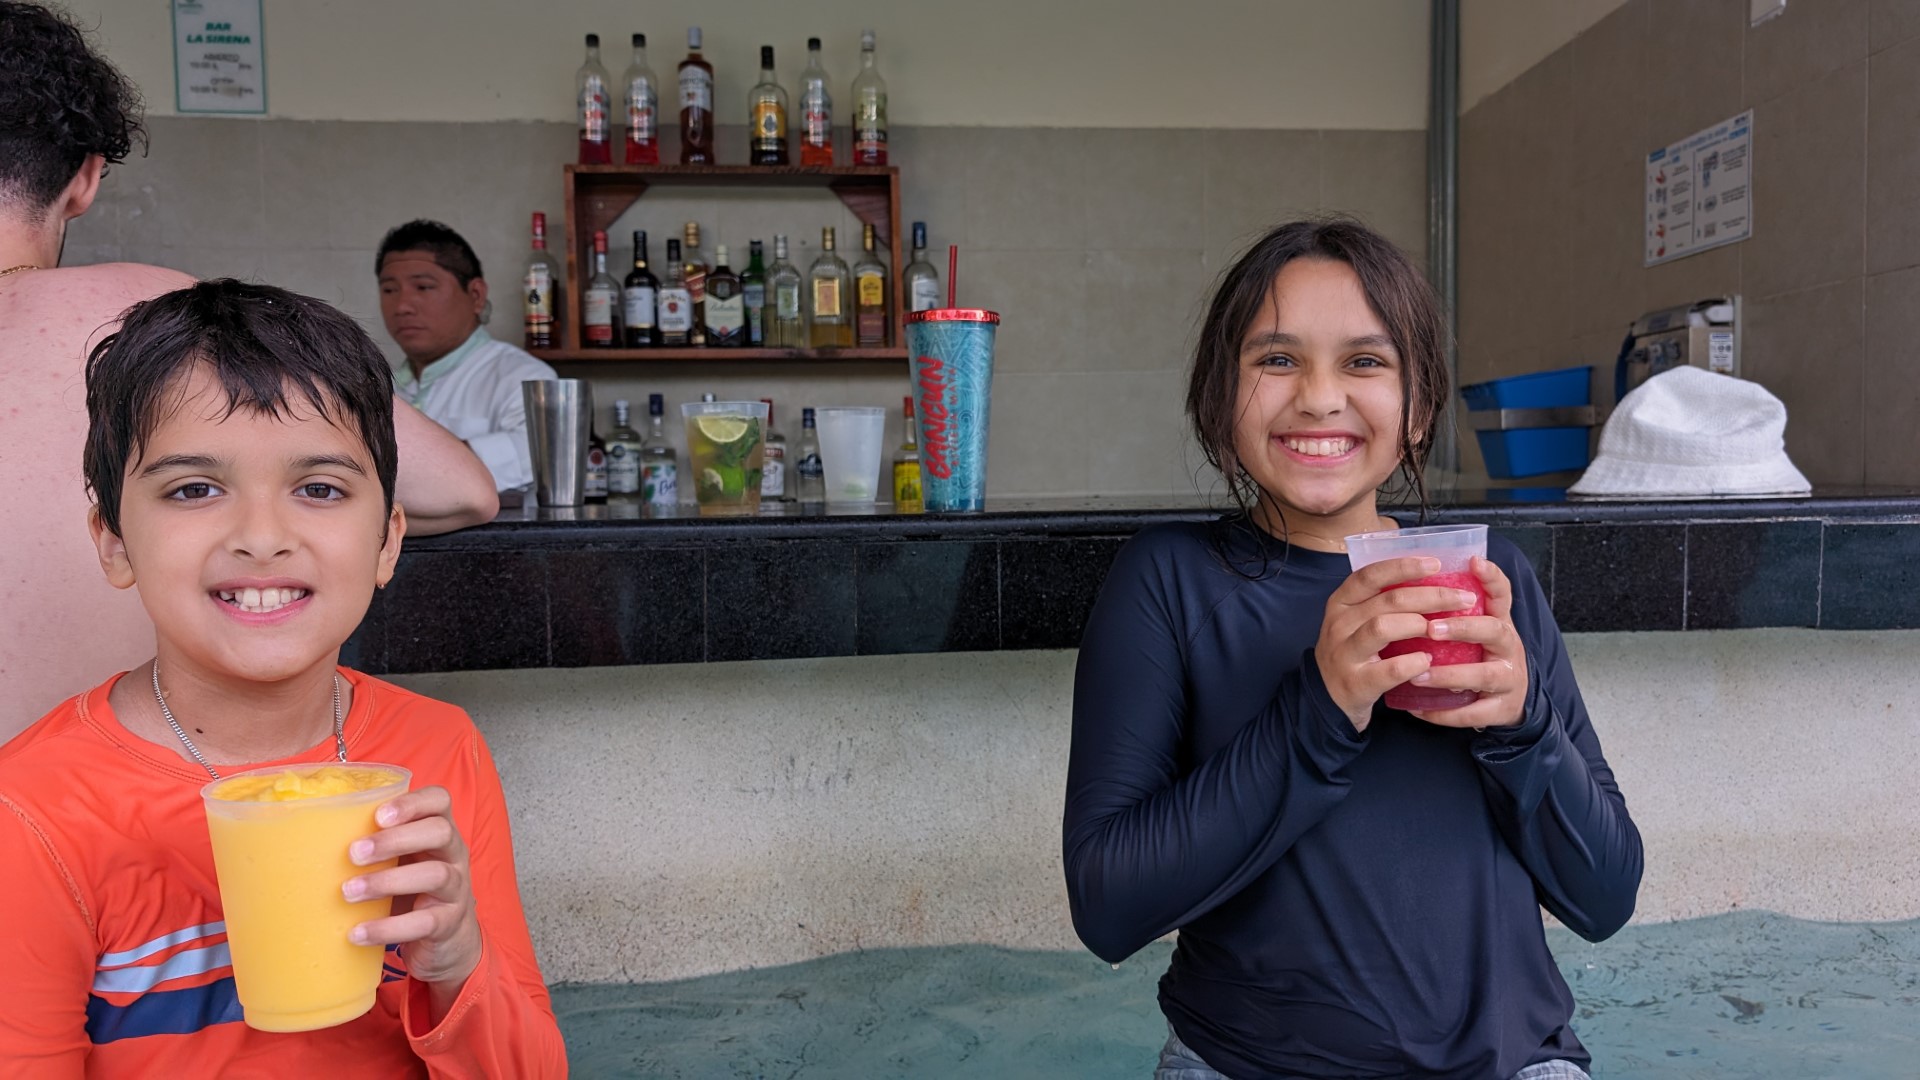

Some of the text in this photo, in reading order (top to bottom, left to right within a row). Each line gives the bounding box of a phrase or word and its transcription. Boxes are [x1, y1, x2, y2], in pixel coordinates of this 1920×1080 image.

[205, 22, 232, 31] BAR
[186, 34, 251, 44] LA SIRENA
[916, 355, 952, 480] CANCUN
